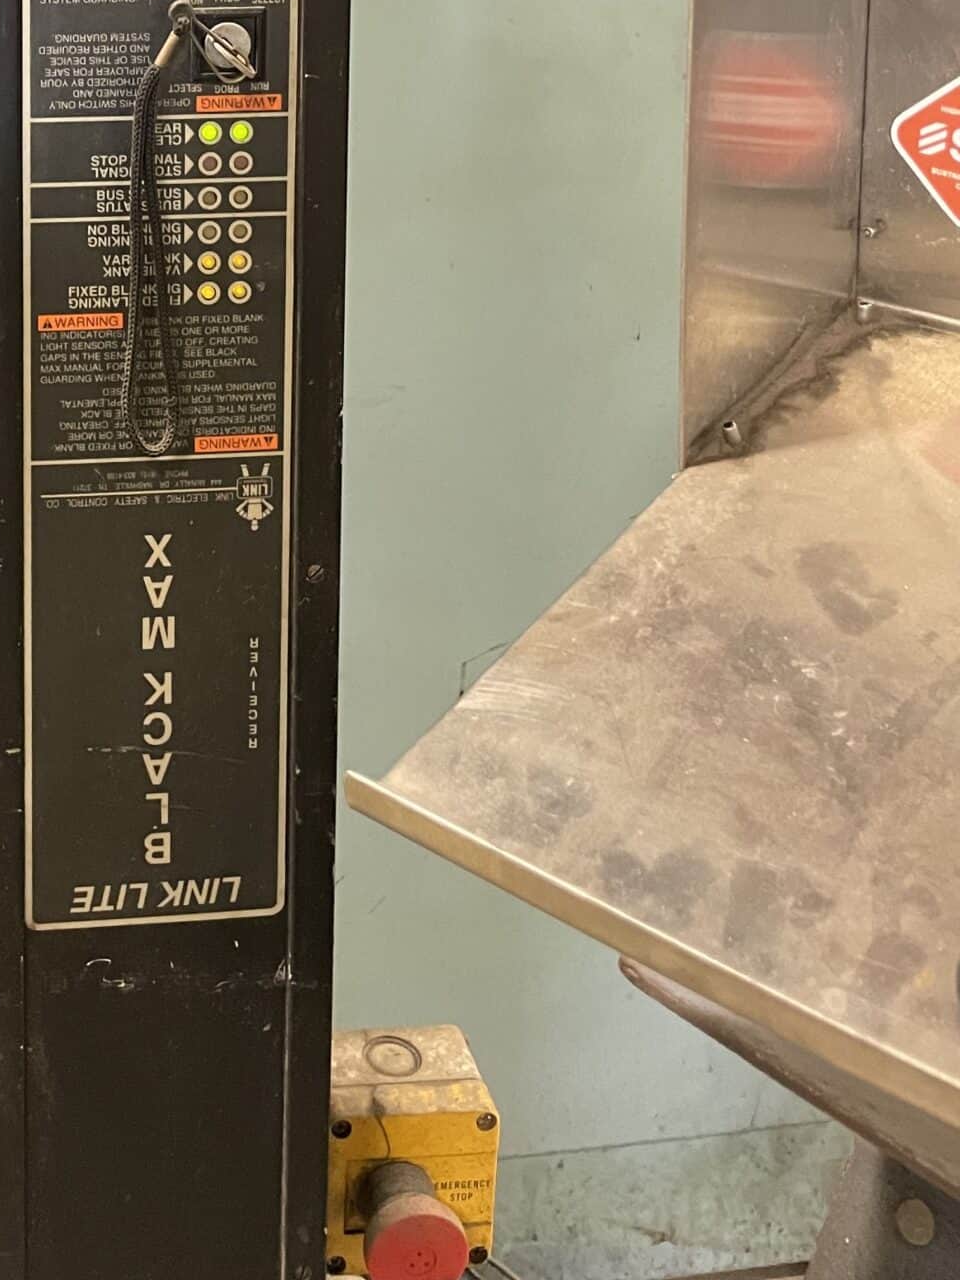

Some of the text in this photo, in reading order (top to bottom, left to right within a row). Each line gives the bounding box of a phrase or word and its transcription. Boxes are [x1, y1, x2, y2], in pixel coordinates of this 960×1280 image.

[110, 33, 150, 42] SYSTEM
[39, 44, 150, 55] AND OTHER REQUIRED
[50, 55, 150, 65] USE OF THIS DEVICE
[45, 67, 93, 76] FOR SAFE
[41, 79, 84, 88] BY YOUR
[169, 82, 269, 93] RUN PROG SELECT
[73, 89, 93, 97] AND
[49, 98, 265, 110] WARNING SWITCH ONLY
[91, 155, 127, 166] STOP
[97, 190, 124, 200] BUS
[87, 225, 107, 235] NO
[163, 235, 181, 245] NO
[103, 255, 130, 265] VAR
[69, 286, 108, 297] FIXED
[55, 314, 263, 328] WARNING FIXED BLANK
[182, 325, 248, 336] ONE OR MORE
[40, 336, 258, 351] LIGHT SENSORS CREATING
[40, 348, 237, 362] GAPS THE SEE BLACK
[40, 359, 257, 373] MAX MANUAL SUPPLEMENTAL
[40, 374, 91, 384] GUARDING
[227, 382, 276, 391] GUARDING
[81, 410, 112, 418] BLACK
[59, 415, 276, 430] LIGHT SENSORS CREATING
[68, 433, 96, 441] MORE
[55, 438, 262, 452] WARNING FIXED BLANK
[242, 483, 269, 497] LINK
[66, 494, 209, 508] ELECTRIC SAFETY CONTROL
[248, 637, 259, 749] RECEIVER
[143, 671, 173, 865] BLACK
[69, 875, 242, 914] LINK LITE
[434, 1180, 490, 1191] EMERGENCY
[450, 1192, 473, 1202] STOP
